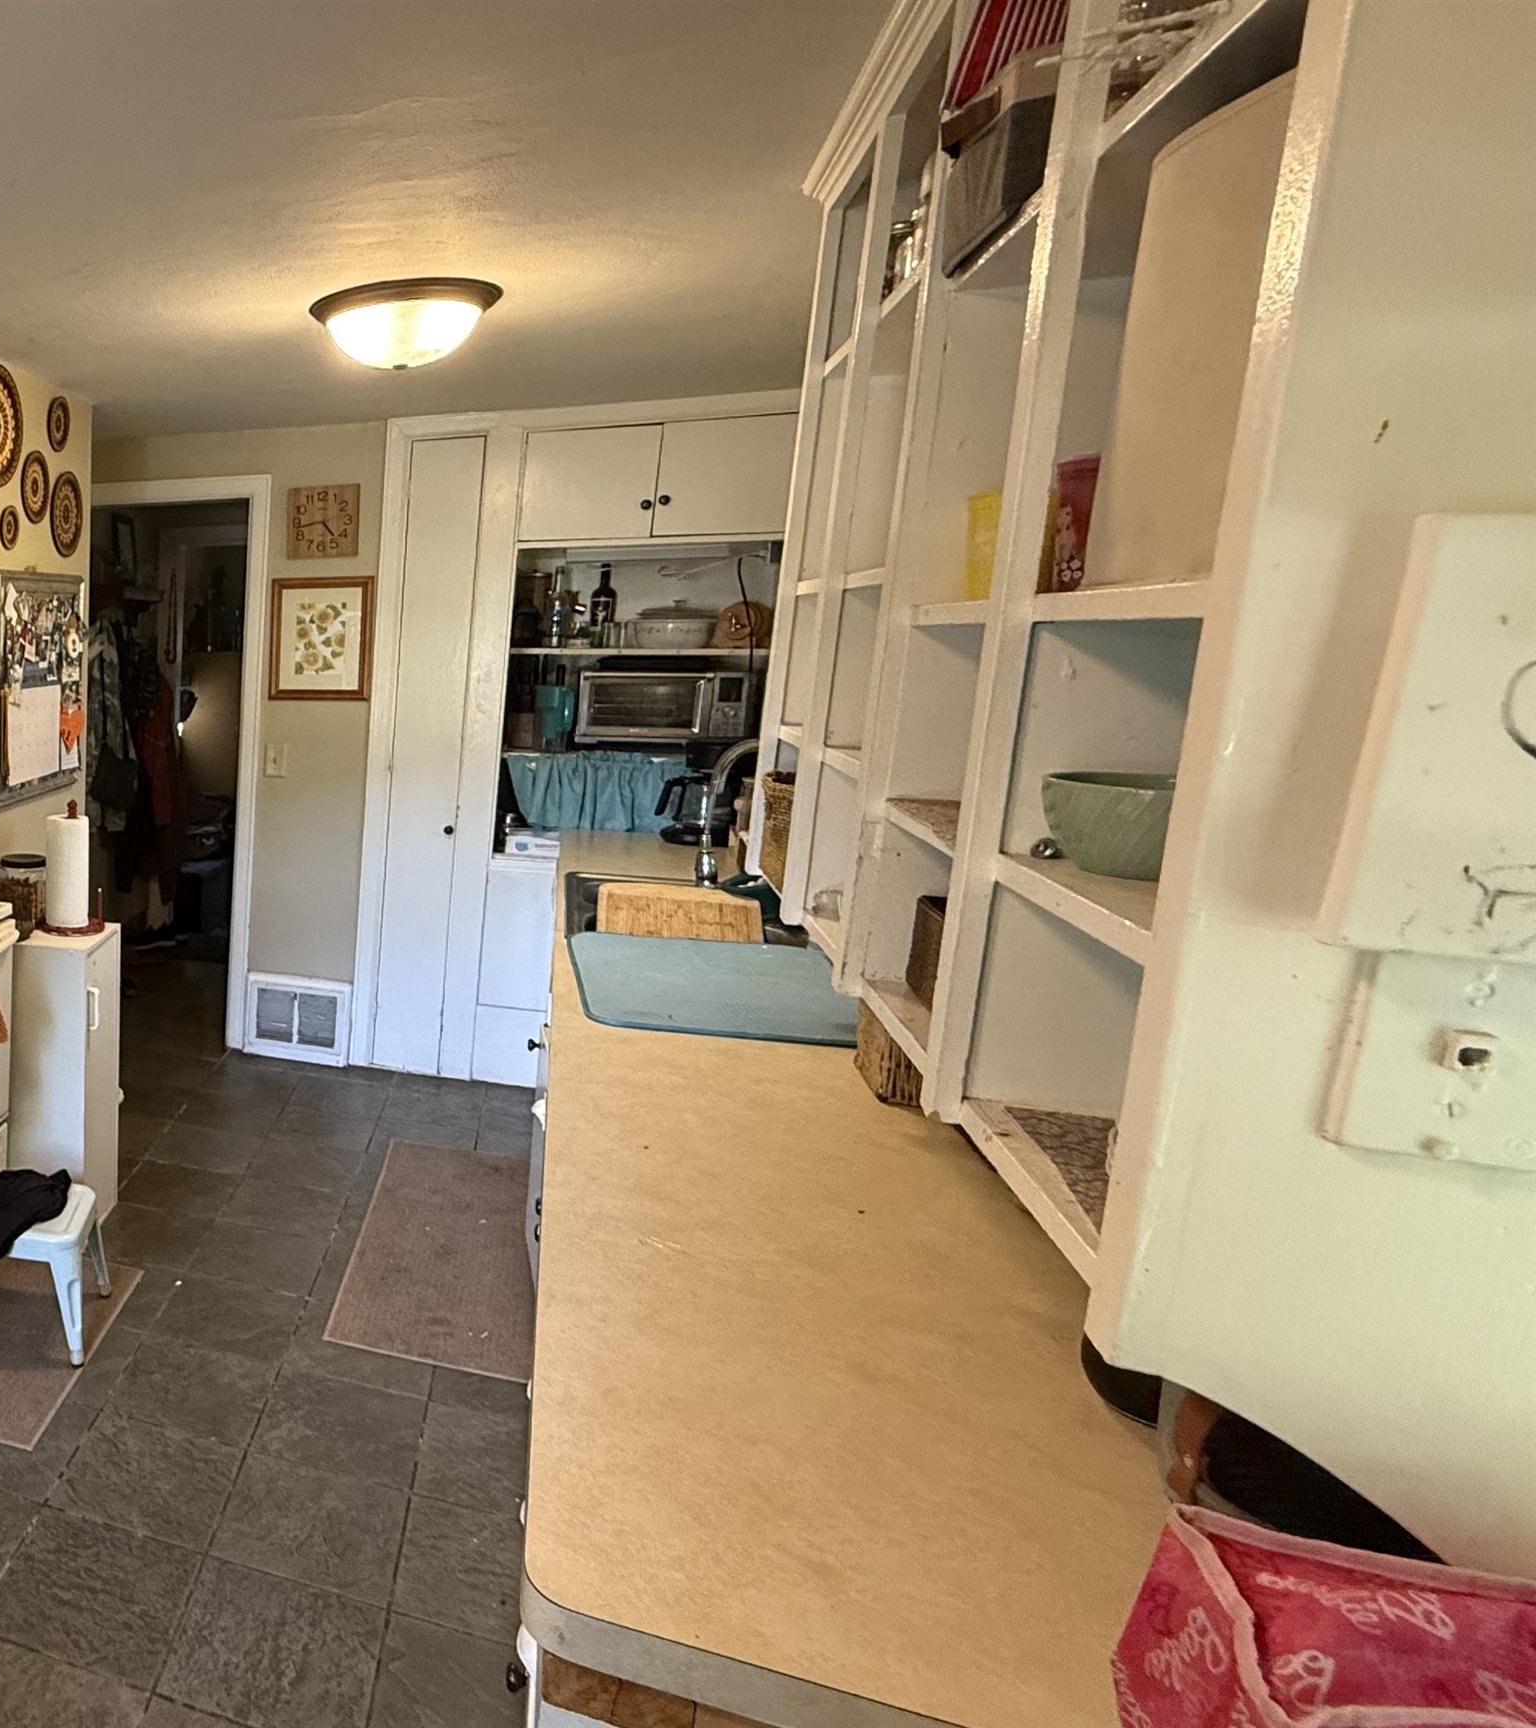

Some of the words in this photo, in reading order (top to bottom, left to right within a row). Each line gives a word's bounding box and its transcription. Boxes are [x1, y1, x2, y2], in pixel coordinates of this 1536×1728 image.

[306, 494, 314, 505] 11
[317, 491, 328, 502] 12
[333, 492, 337, 503] 1
[296, 504, 307, 515] 10
[339, 500, 349, 512] 2
[292, 517, 302, 528] 9
[343, 513, 353, 526] 3
[295, 529, 305, 541] 8
[338, 528, 348, 539] 4
[306, 539, 314, 551] 7
[316, 541, 326, 552] 6
[329, 538, 339, 550] 5
